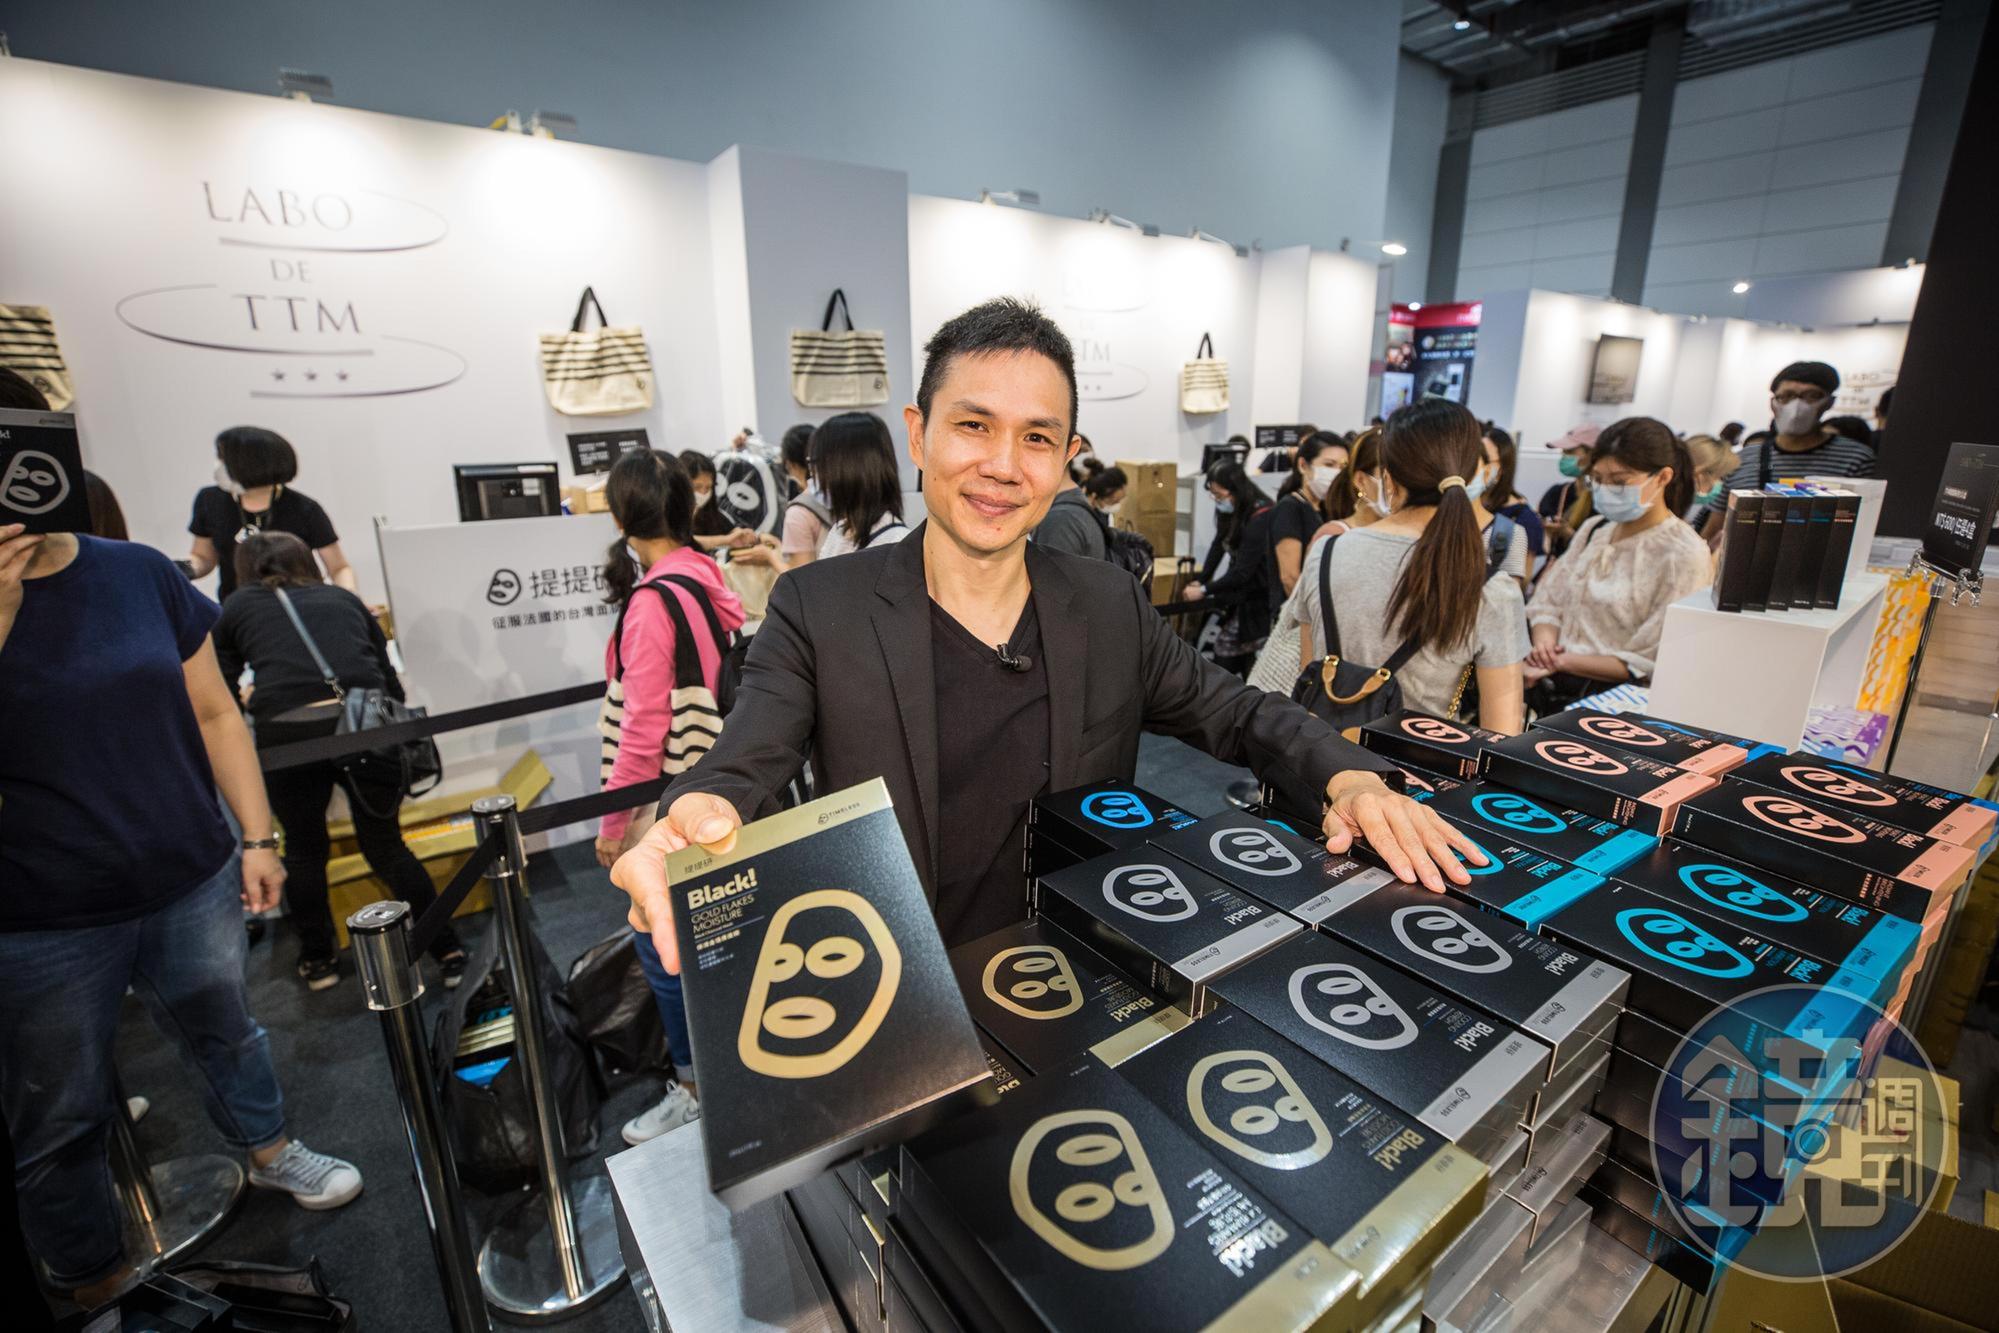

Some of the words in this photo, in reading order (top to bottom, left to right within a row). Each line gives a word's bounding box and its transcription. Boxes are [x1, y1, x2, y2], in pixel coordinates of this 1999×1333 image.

[201, 181, 353, 231] LABO
[270, 258, 313, 283] DE
[231, 294, 363, 334] TTM
[688, 867, 758, 910] Black!
[691, 906, 721, 924] GOLD
[721, 894, 755, 914] FLAKES
[693, 908, 743, 934] MOISTURE
[1224, 905, 1262, 926] Black!
[1544, 952, 1579, 976] Black!
[1110, 996, 1154, 1022] Black!
[1454, 1021, 1495, 1052] Black!
[1374, 1128, 1426, 1171] Black!
[1219, 1219, 1288, 1277] Black!
